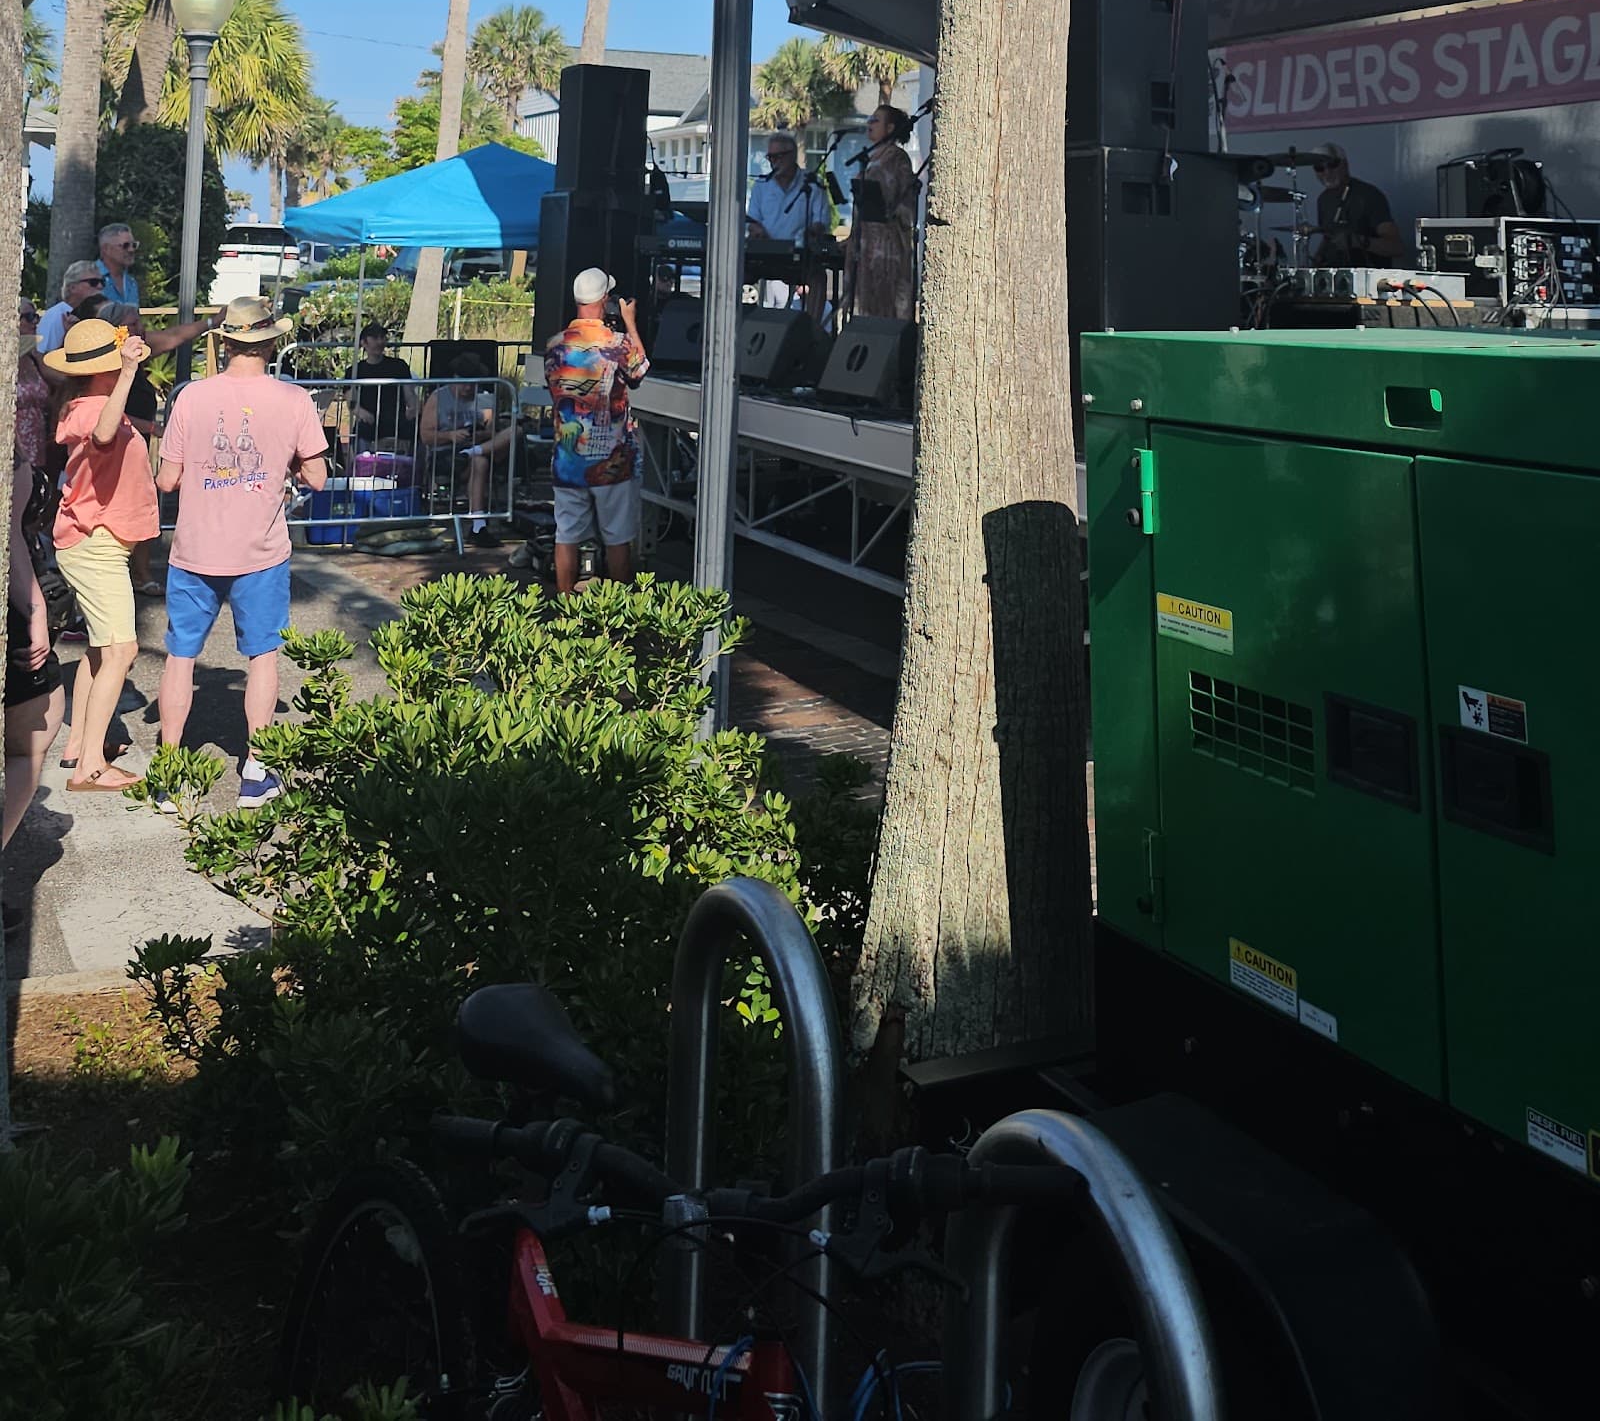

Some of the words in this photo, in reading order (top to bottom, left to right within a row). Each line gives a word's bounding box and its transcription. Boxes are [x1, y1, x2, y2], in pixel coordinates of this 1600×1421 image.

[1228, 39, 1421, 118] SLIDERS
[676, 239, 702, 248] YAMAHA
[1178, 602, 1221, 625] CAUTION
[1244, 950, 1293, 986] CAUTION
[1529, 1111, 1559, 1135] DIESEL
[1561, 1127, 1584, 1148] FUEL
